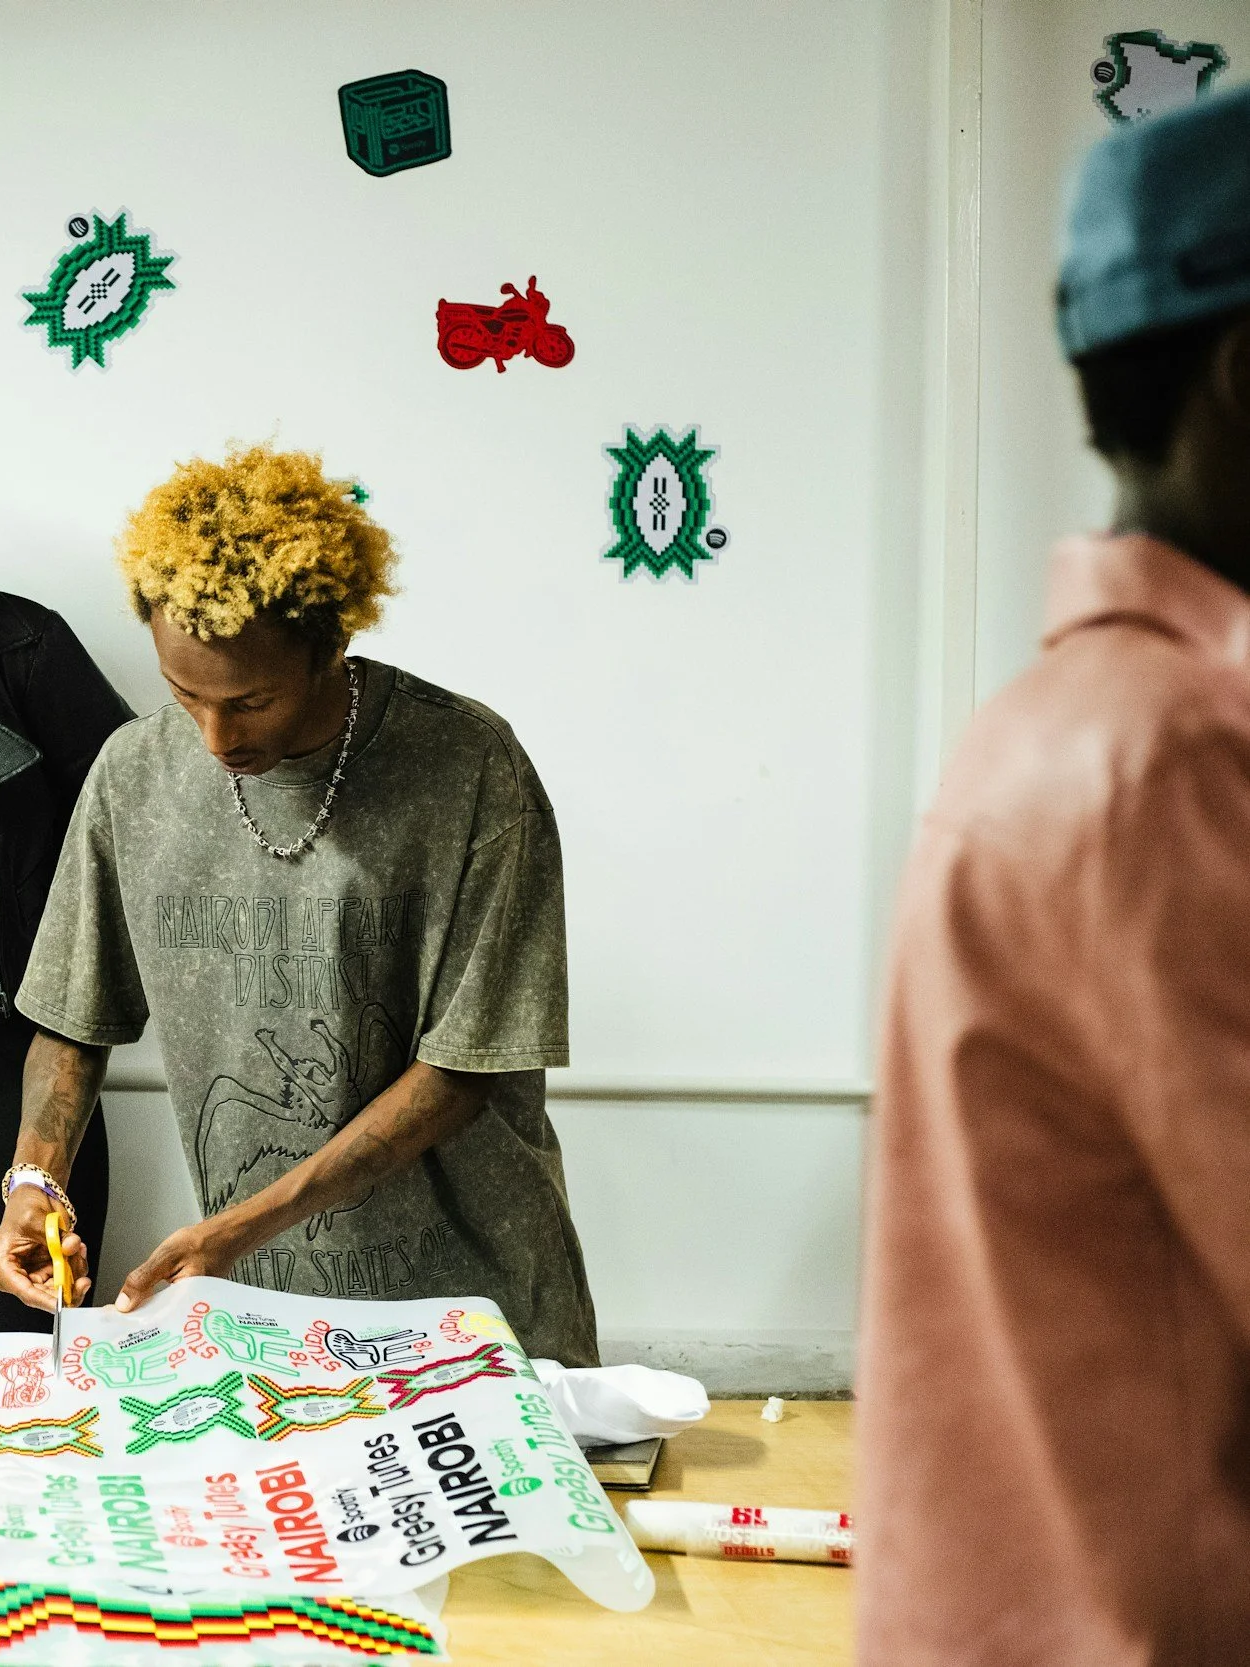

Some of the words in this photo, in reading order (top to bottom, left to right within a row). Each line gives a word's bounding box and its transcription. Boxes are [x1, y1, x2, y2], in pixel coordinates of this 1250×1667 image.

[156, 895, 288, 954] NAIROBI
[235, 951, 374, 1015] DISTRICT
[311, 1235, 415, 1297] STATES
[420, 1220, 454, 1279] OF
[119, 1330, 161, 1350] NAIROBI
[183, 1301, 219, 1359] STUDIO
[289, 1350, 310, 1369] 18
[239, 1319, 278, 1327] NAIROBI
[304, 1319, 342, 1372] STUDIO
[413, 1340, 434, 1355] 18
[439, 1309, 478, 1344] STUDIO
[62, 1335, 97, 1392] STUDIO
[168, 1347, 187, 1369] 18
[515, 1393, 571, 1449] Tunes
[204, 1472, 249, 1520] Tunes
[364, 1433, 413, 1498] Tunes
[412, 1412, 518, 1547] NAIROBI
[547, 1453, 616, 1533] Greasy
[97, 1475, 168, 1573] NAIROBI
[219, 1524, 271, 1579] Greasy
[255, 1461, 343, 1583] NAIROBI
[388, 1491, 446, 1566] Greasy
